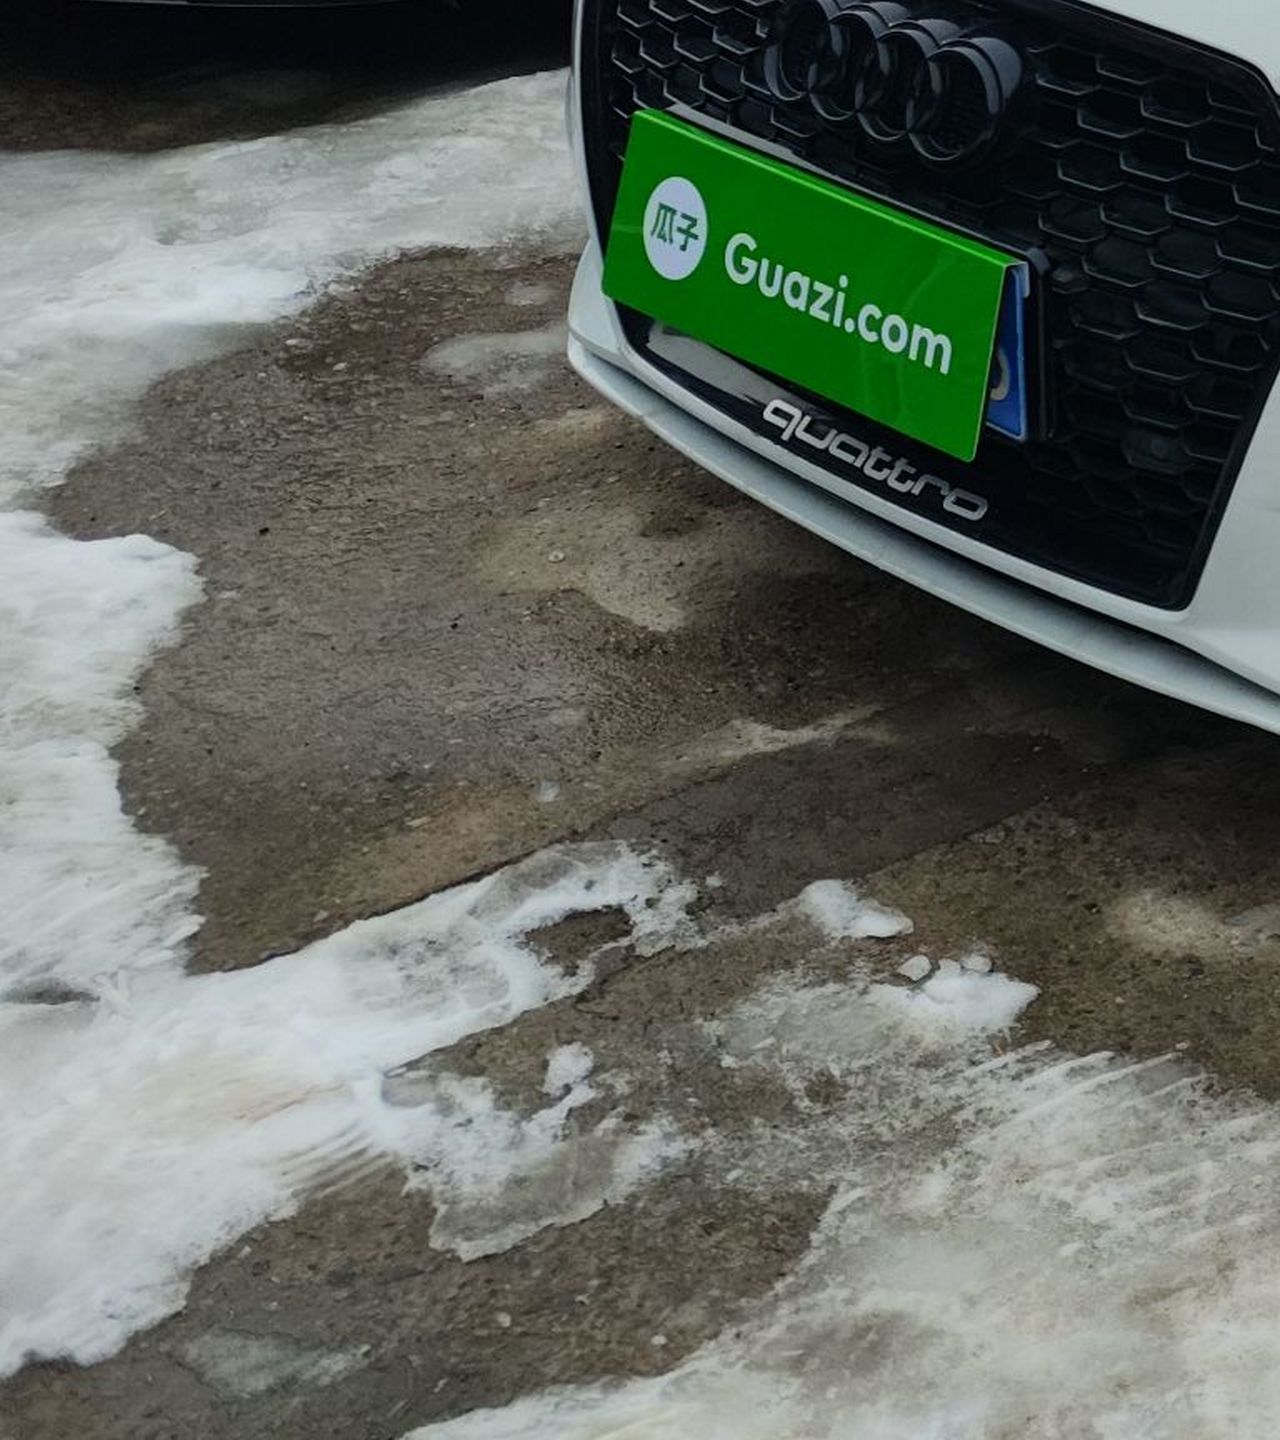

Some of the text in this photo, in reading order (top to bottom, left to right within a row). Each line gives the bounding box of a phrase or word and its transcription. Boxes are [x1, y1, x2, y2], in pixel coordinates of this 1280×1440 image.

[651, 201, 700, 252] 瓜子
[724, 232, 953, 376] Guazi.com
[762, 398, 989, 522] quattro
